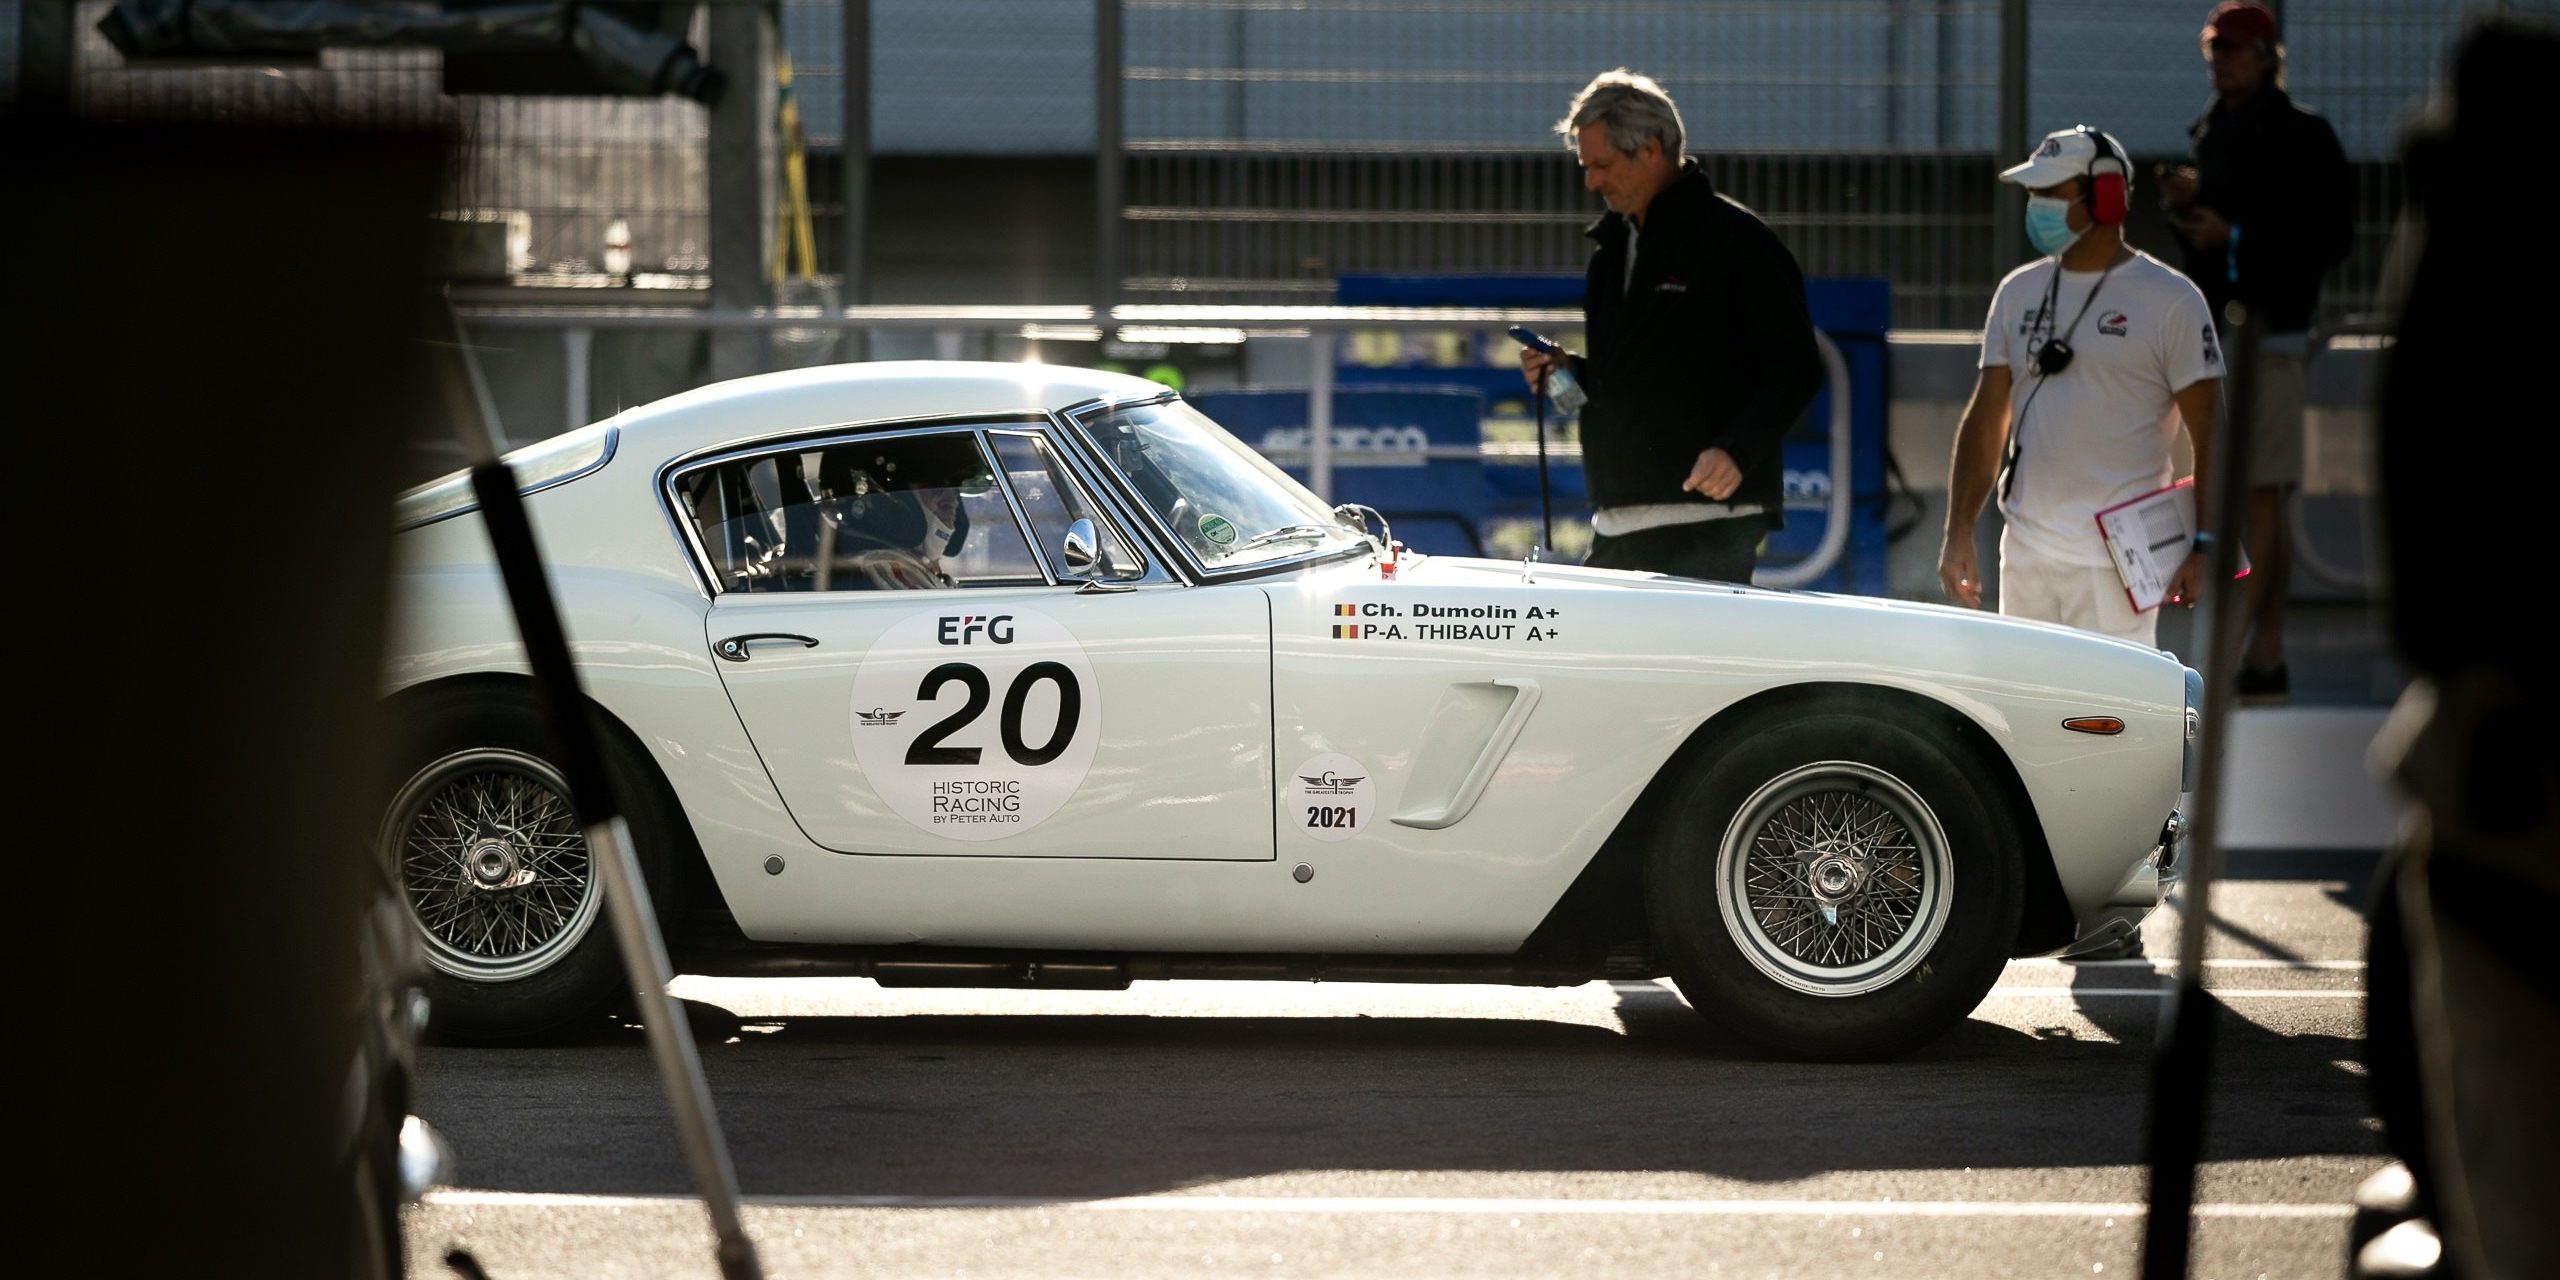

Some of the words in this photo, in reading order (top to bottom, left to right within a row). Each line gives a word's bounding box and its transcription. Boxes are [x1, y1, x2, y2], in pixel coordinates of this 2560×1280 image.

[1362, 603, 1402, 617] Ch.
[1413, 604, 1517, 619] Dumolin
[1525, 606, 1560, 620] A+
[938, 615, 1014, 645] EFG
[1363, 624, 1407, 640] P-A.
[1415, 624, 1516, 641] THIBAUT
[904, 660, 1081, 766] 20
[933, 780, 1020, 794] HISTORIC
[933, 795, 1020, 813] RACING
[950, 814, 987, 824] PETER
[989, 814, 1020, 824] AUTO
[1307, 806, 1356, 828] 2021
